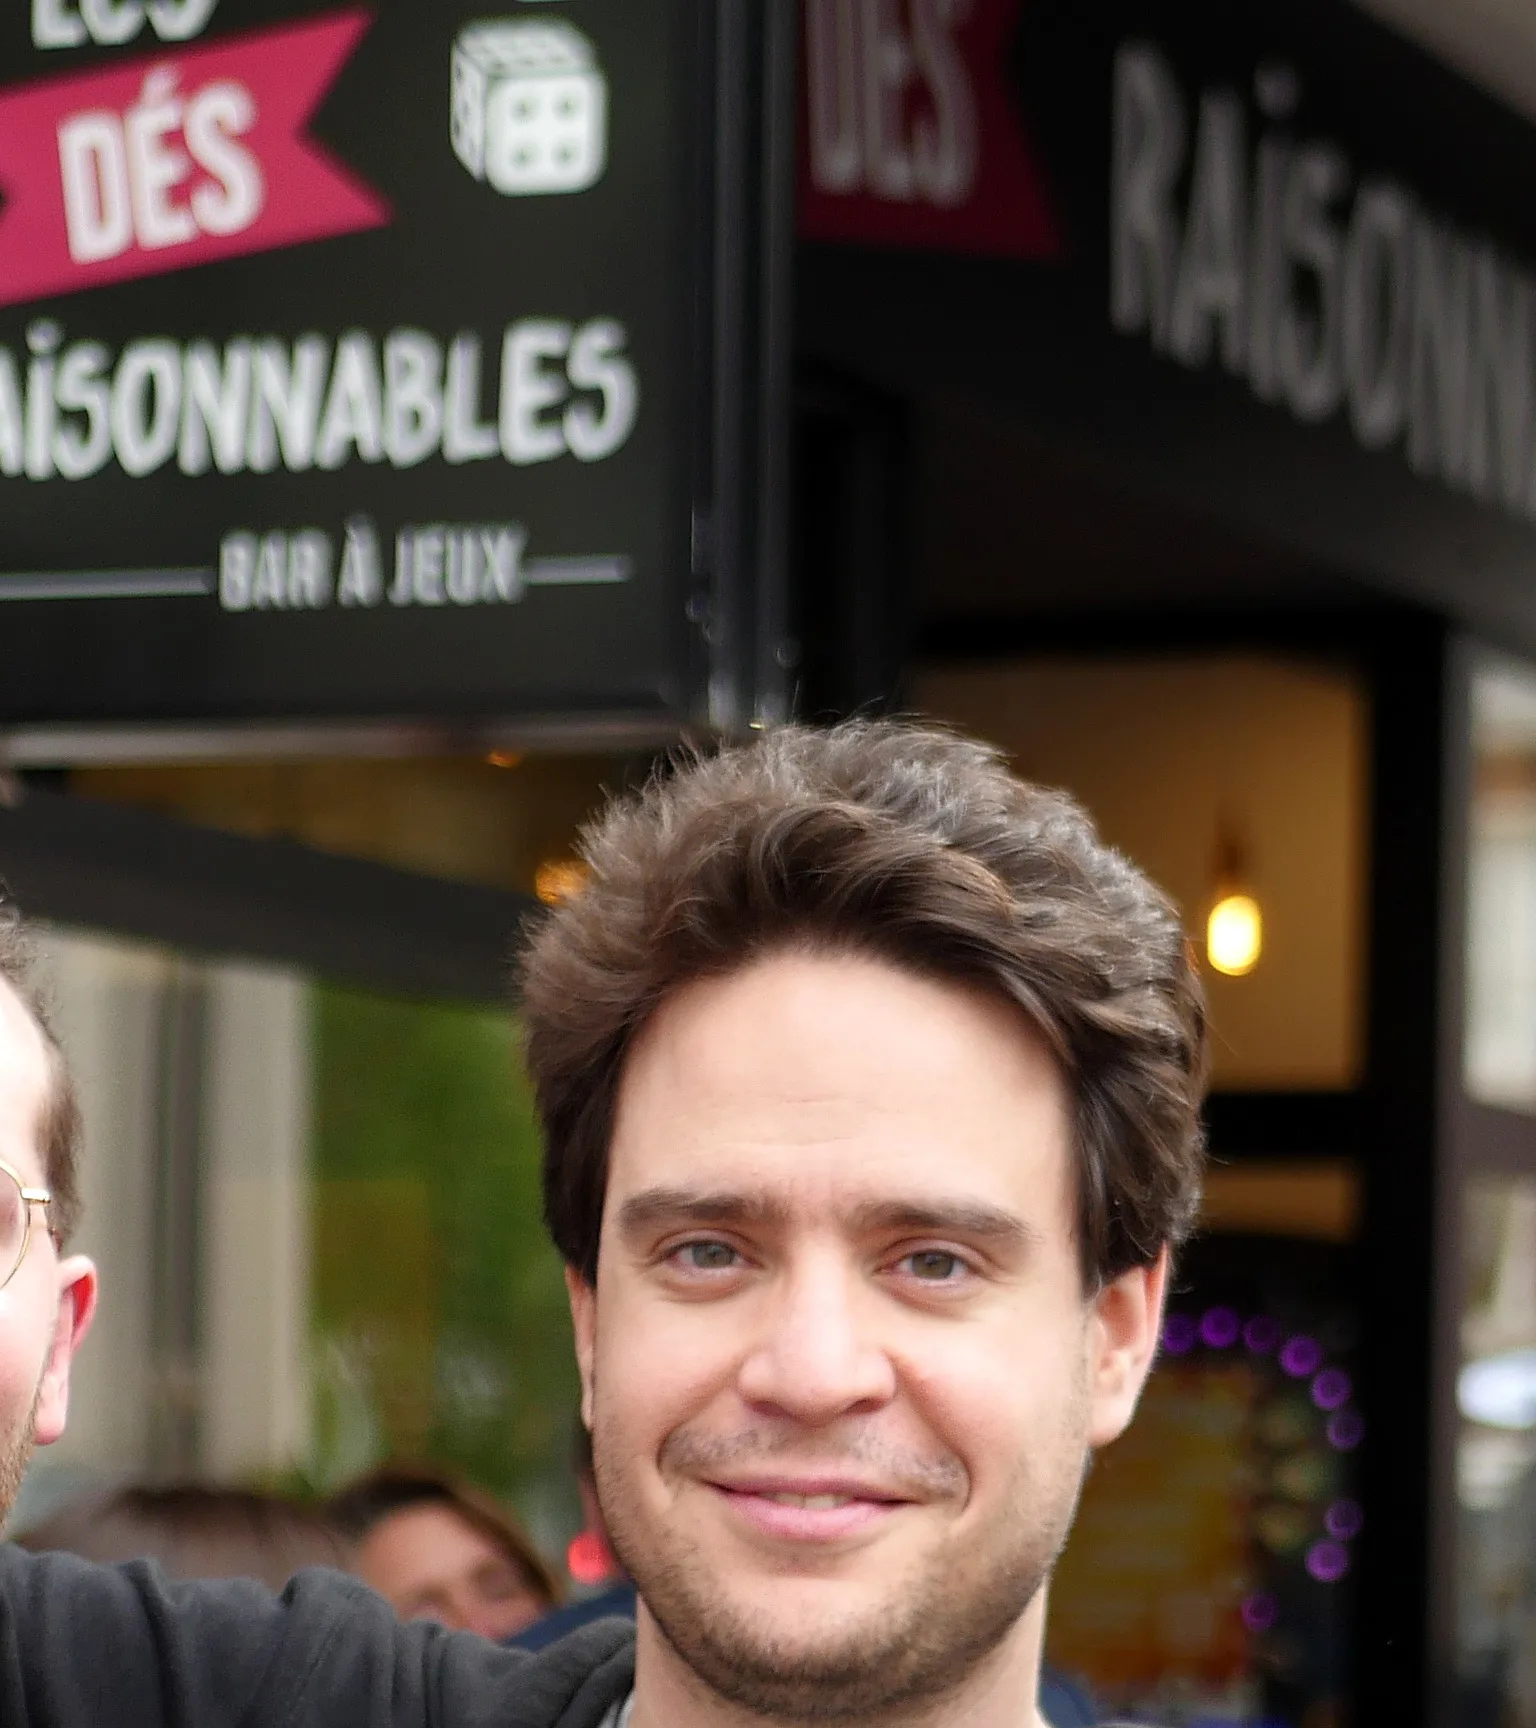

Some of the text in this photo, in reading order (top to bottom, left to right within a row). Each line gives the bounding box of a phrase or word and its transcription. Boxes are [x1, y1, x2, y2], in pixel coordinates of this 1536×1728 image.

[56, 63, 265, 264] DÉS
[219, 513, 526, 611] BAR À JEUX
